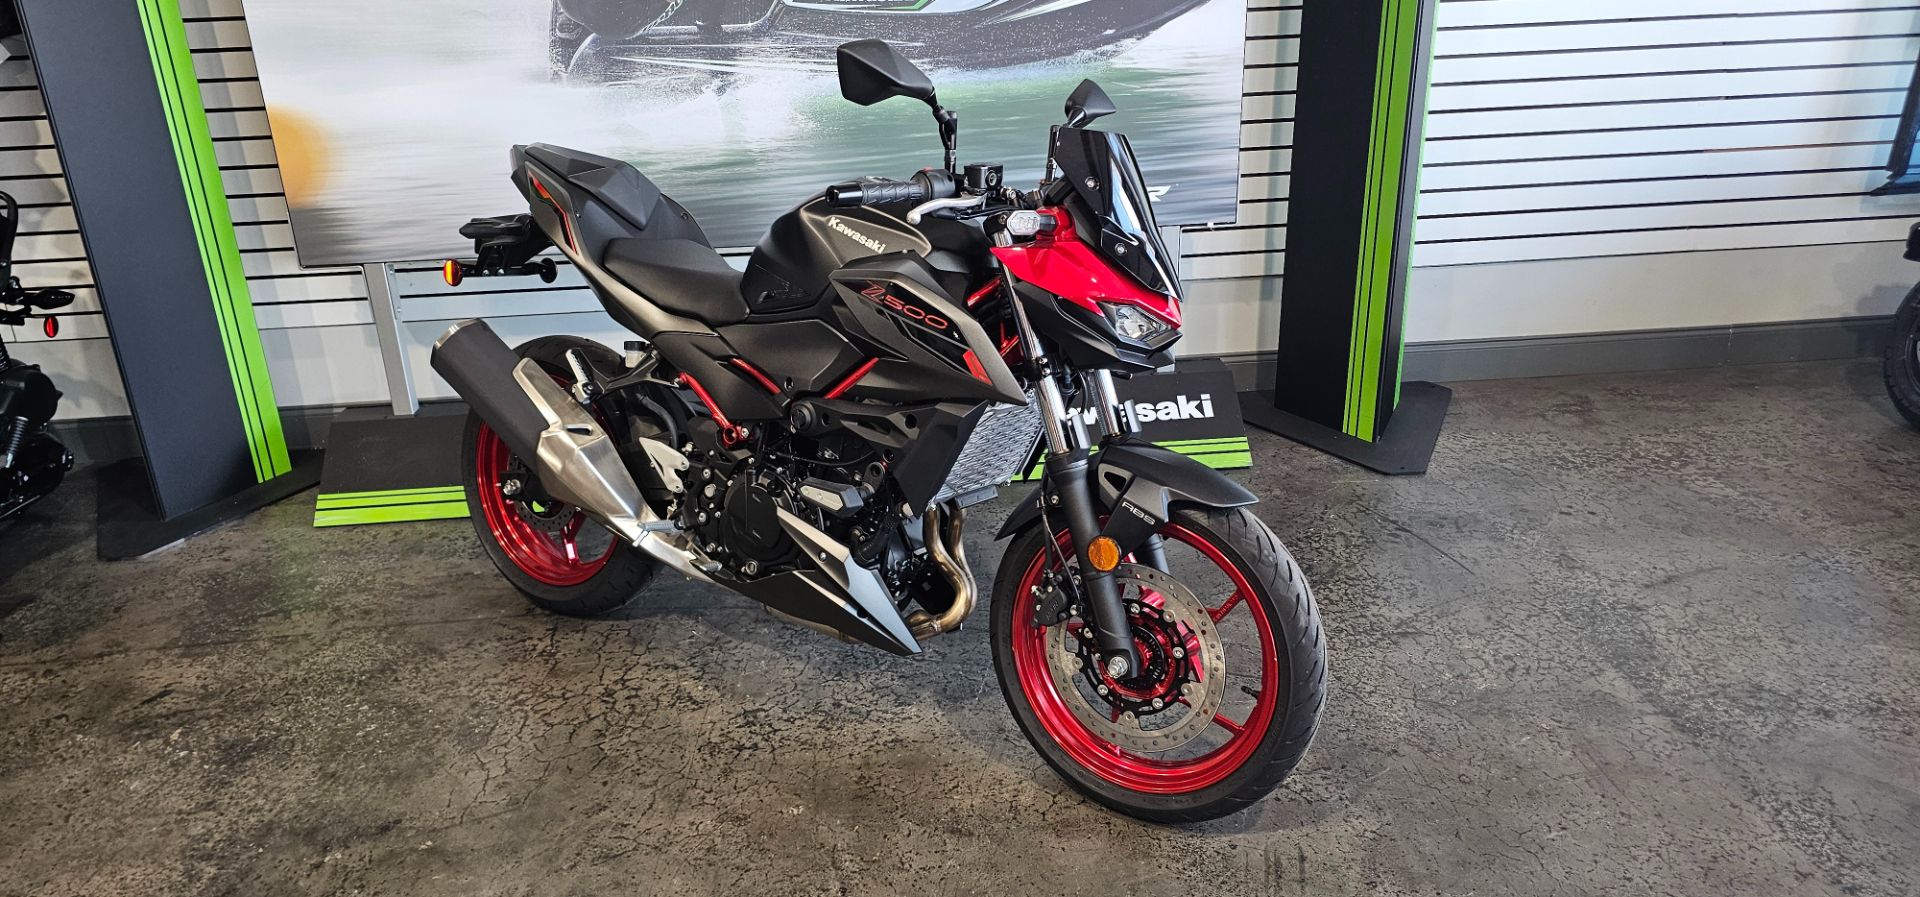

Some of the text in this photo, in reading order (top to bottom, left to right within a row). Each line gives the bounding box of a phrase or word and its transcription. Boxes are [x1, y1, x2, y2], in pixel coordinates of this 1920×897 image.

[828, 216, 886, 253] Kawasaki
[1066, 393, 1215, 425] awsaki
[1122, 501, 1156, 525] ABS
